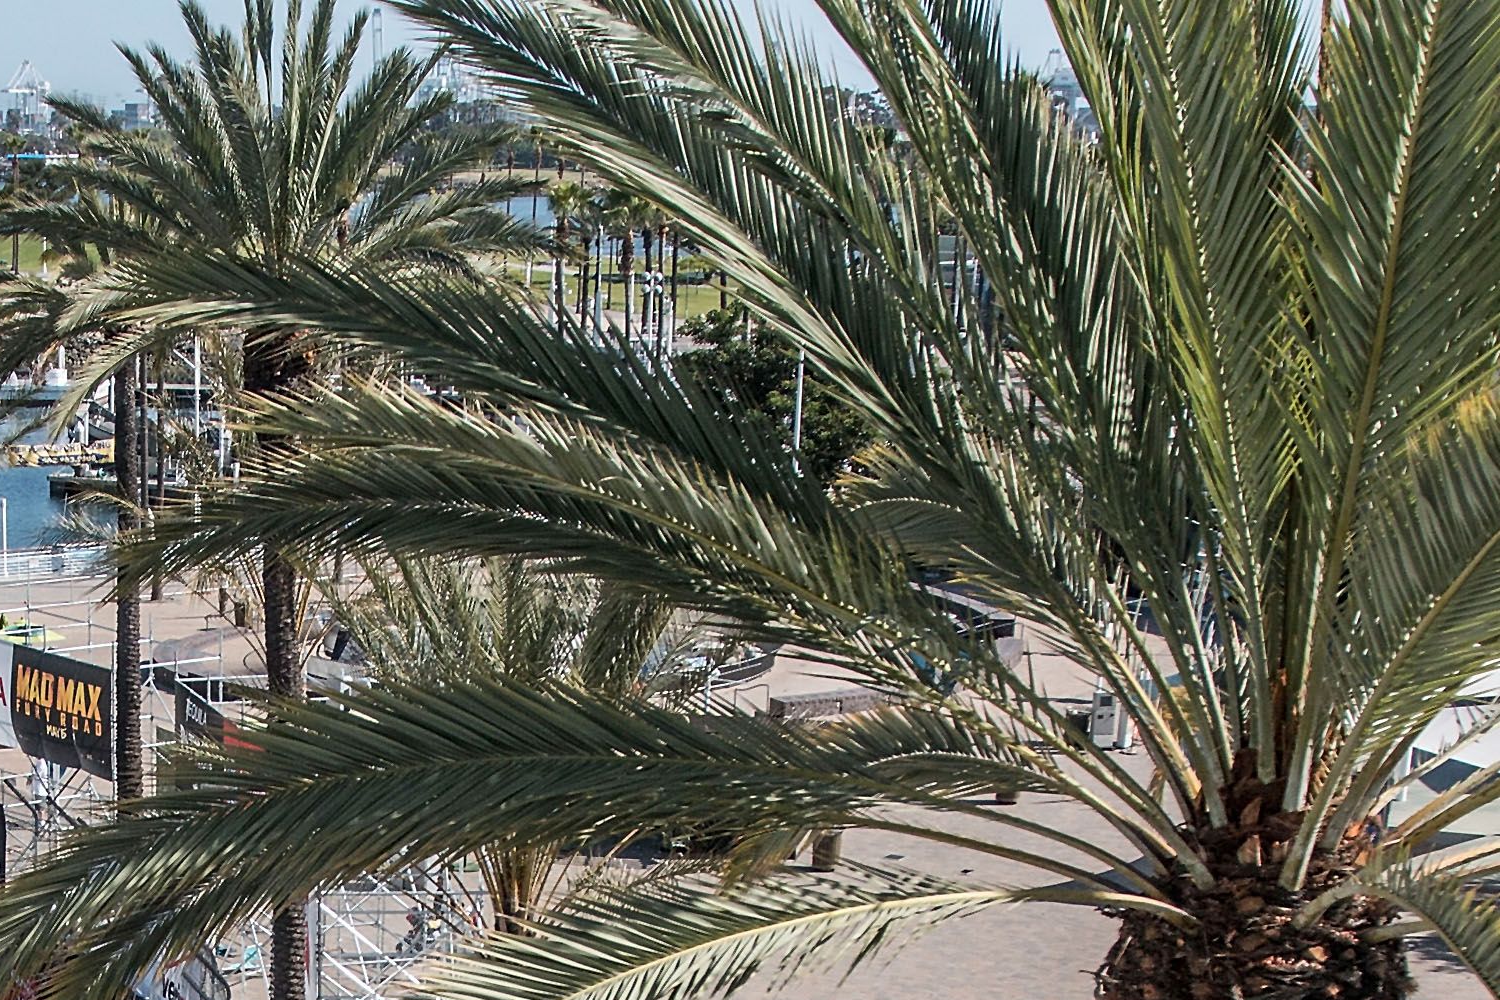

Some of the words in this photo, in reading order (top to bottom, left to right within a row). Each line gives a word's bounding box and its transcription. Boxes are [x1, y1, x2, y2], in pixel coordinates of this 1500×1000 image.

[16, 664, 55, 708] MAD
[56, 676, 102, 720] MAX
[16, 701, 51, 722] FURY
[60, 712, 102, 737] ROAD
